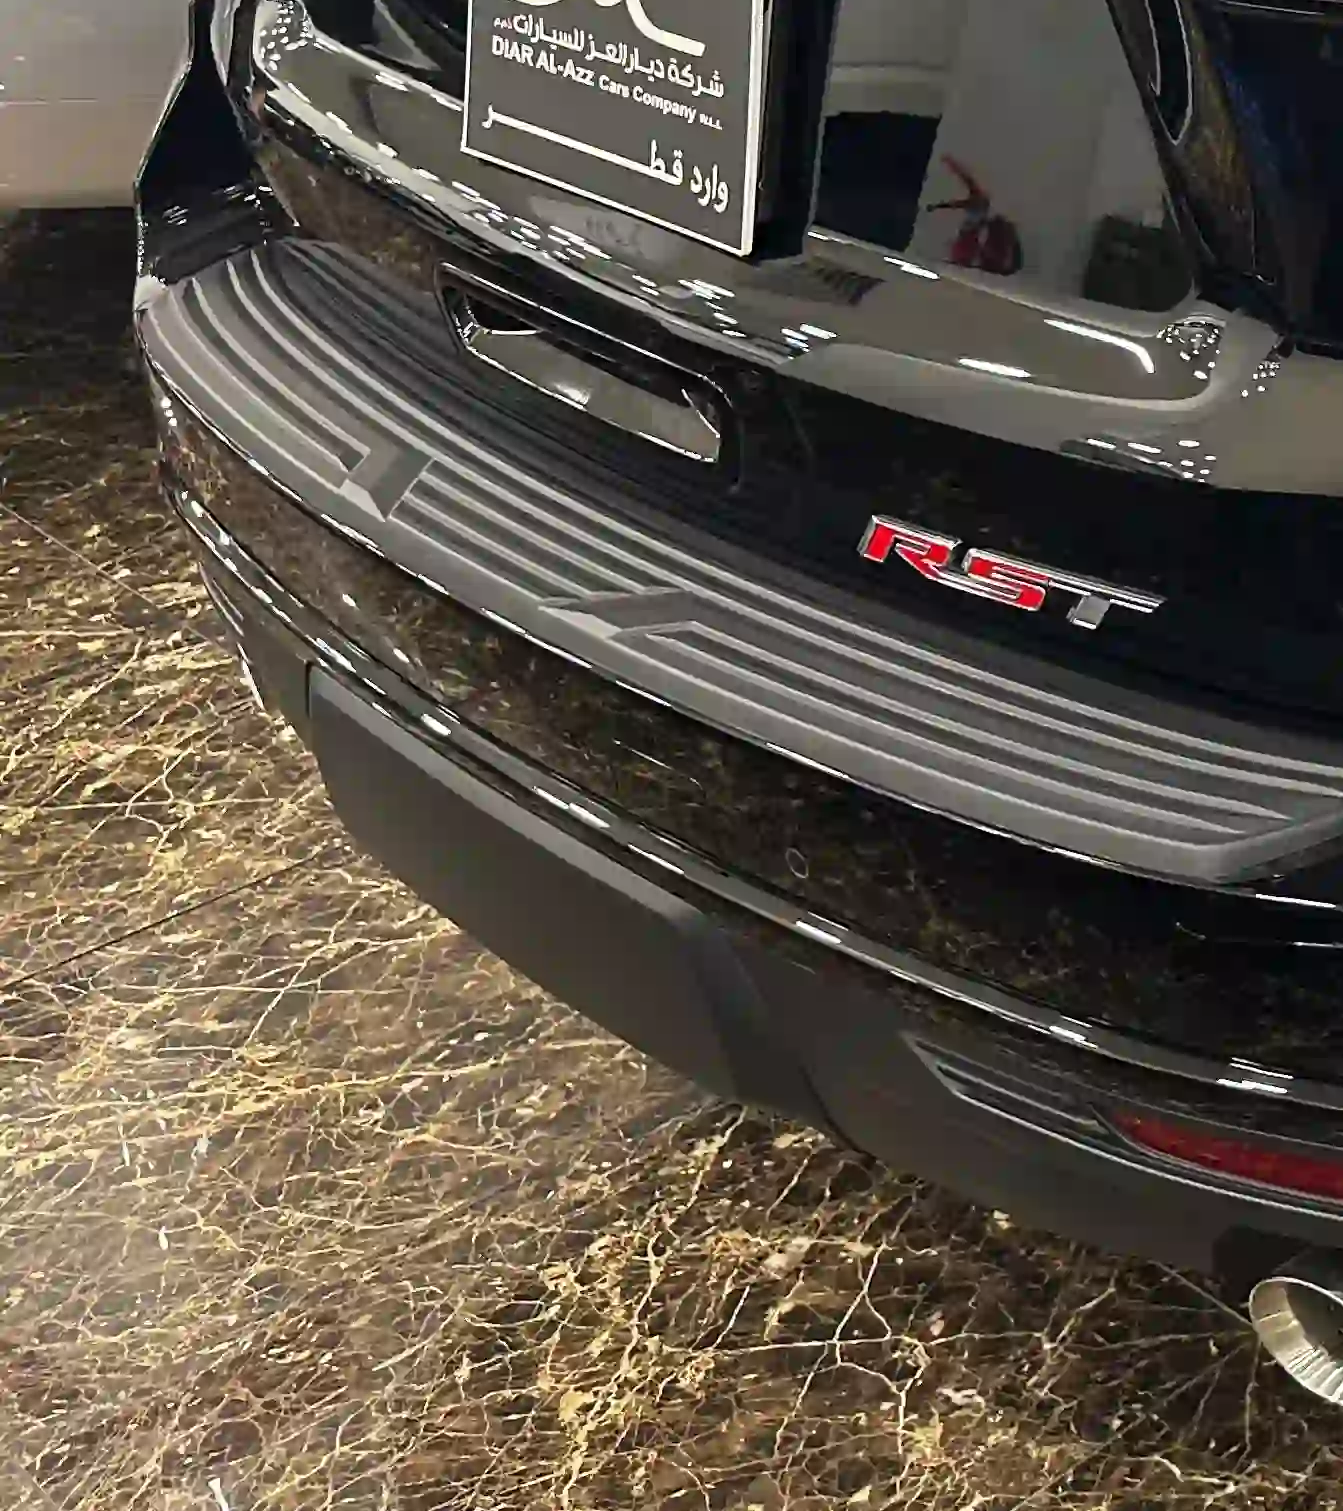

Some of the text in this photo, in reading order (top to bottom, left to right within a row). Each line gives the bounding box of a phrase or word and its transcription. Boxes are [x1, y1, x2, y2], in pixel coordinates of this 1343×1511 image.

[512, 13, 585, 53] للسيارات
[584, 34, 628, 67] العز
[491, 34, 536, 67] DIAR
[598, 74, 630, 98] Cars
[632, 84, 697, 124] Company
[624, 46, 666, 82] ديار
[667, 57, 725, 98] شركة
[481, 102, 730, 214] وارد قطر
[856, 514, 1167, 631] RST
